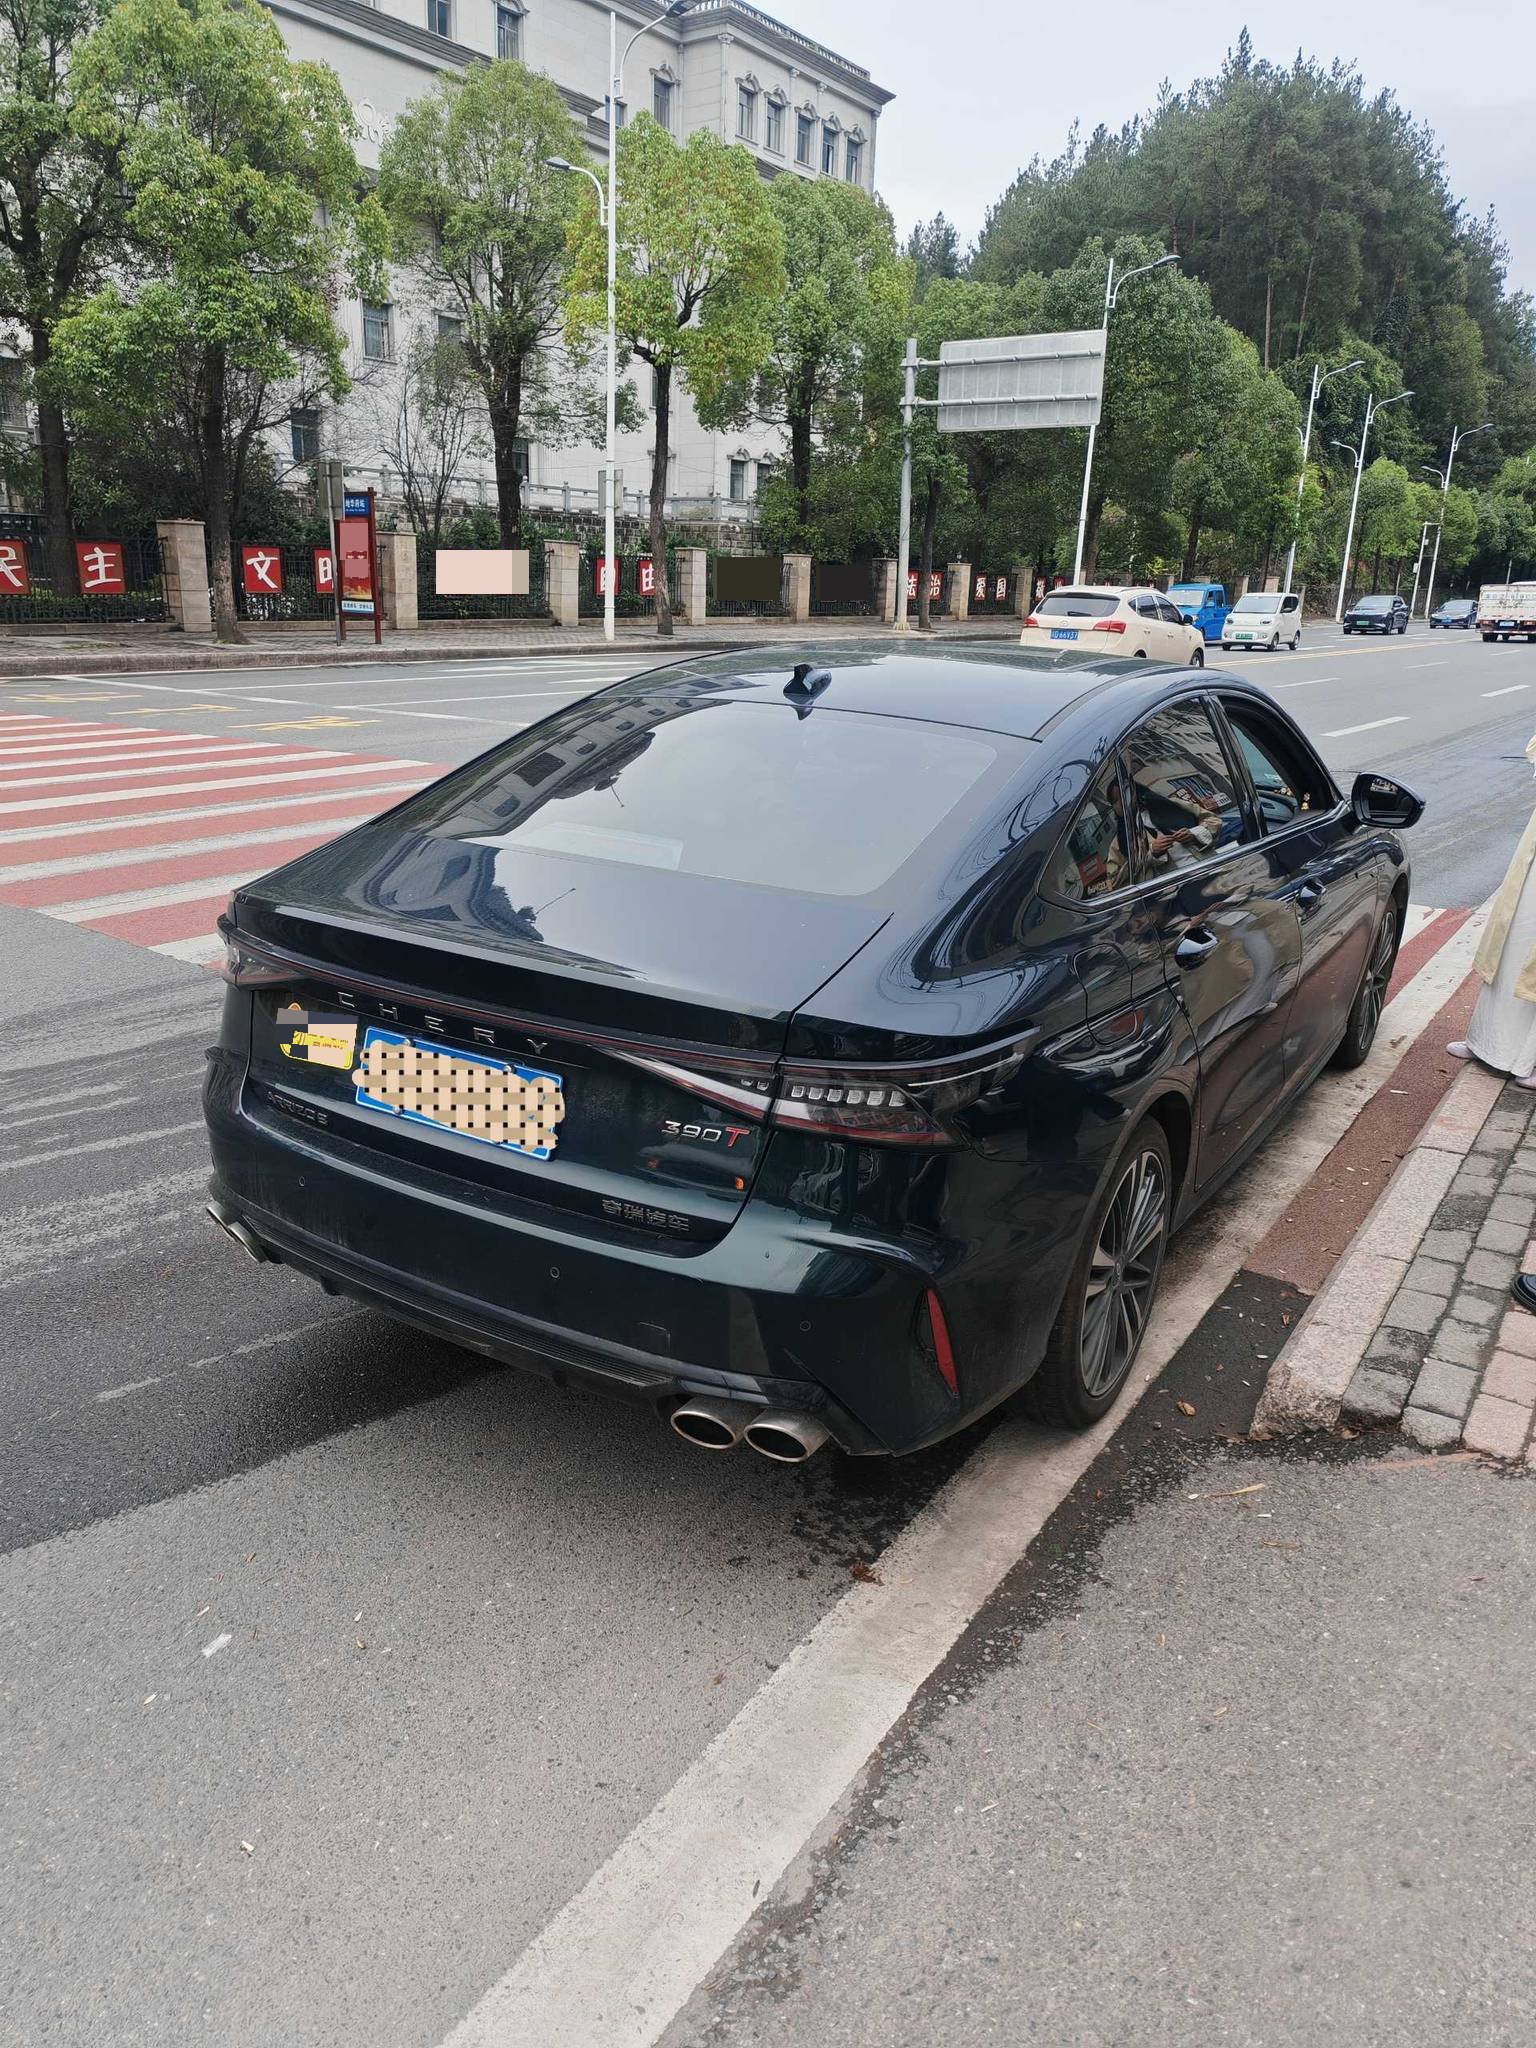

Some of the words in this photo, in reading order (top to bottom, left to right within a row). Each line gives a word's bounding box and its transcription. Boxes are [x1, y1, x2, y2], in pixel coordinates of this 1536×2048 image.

[83, 546, 121, 588] 主
[246, 551, 278, 589] 文
[337, 991, 548, 1055] CHERY
[660, 1120, 751, 1148] 390T
[601, 1198, 690, 1232] 奇瑞汽车
